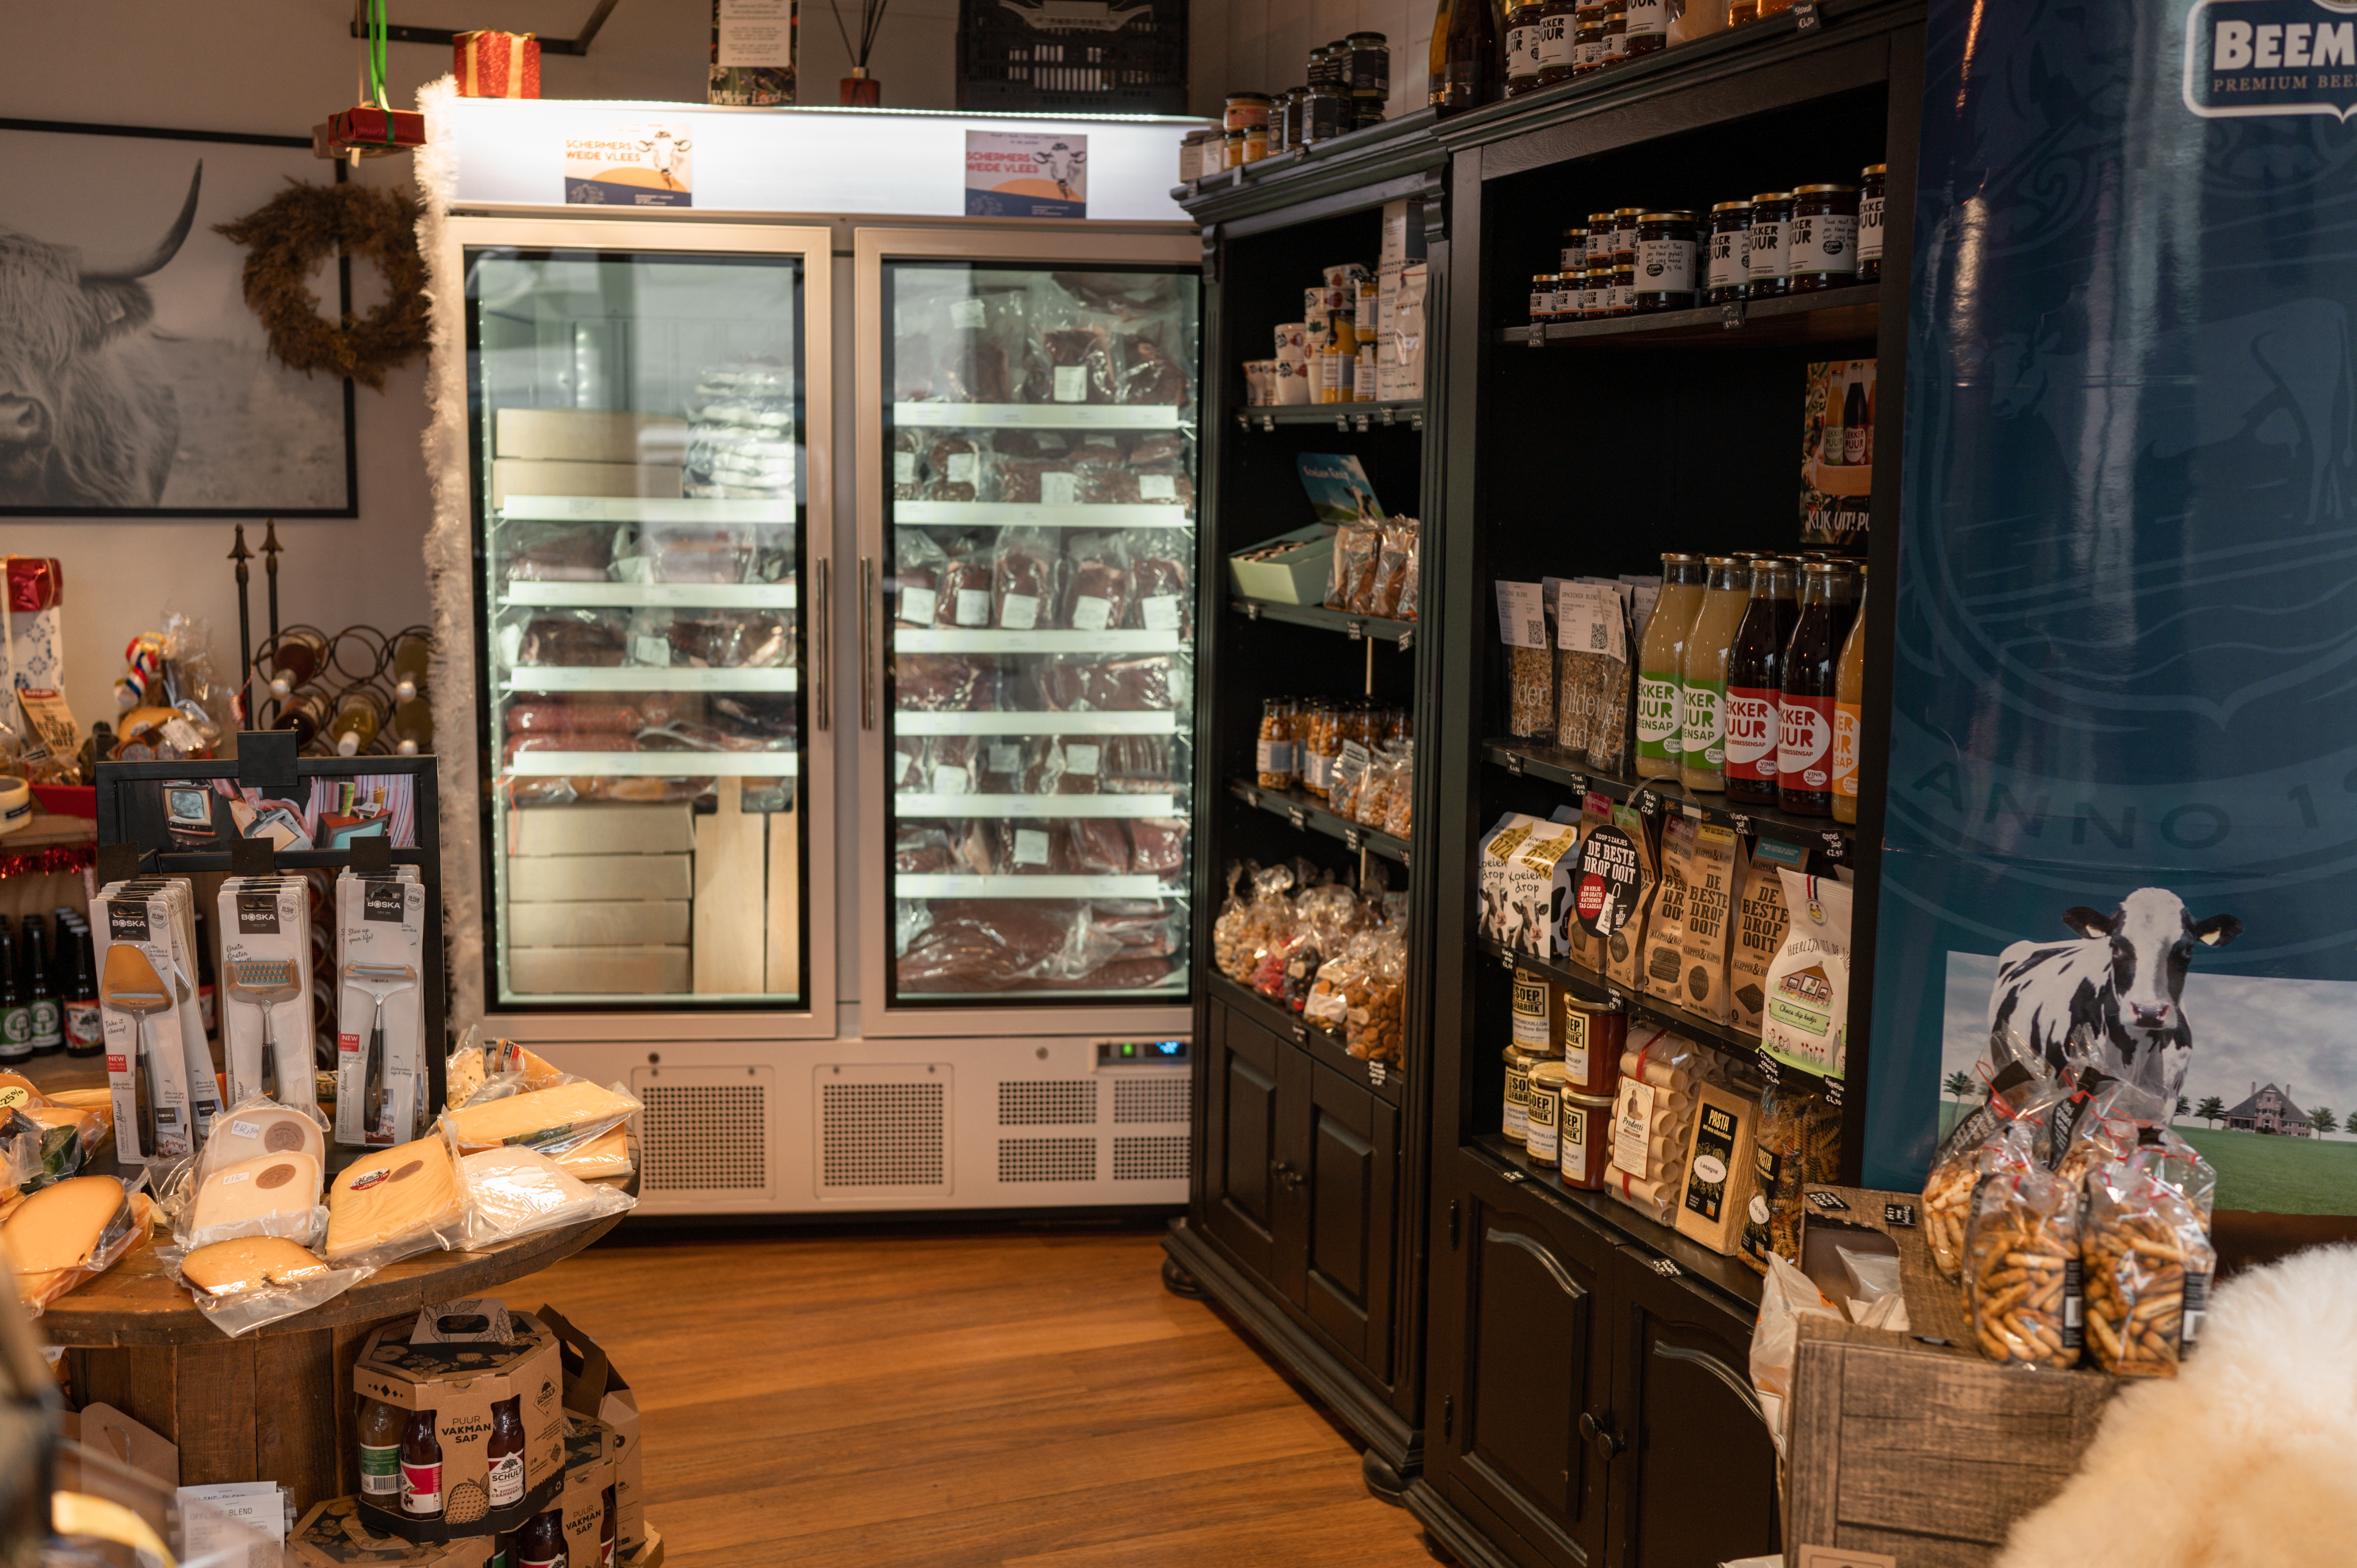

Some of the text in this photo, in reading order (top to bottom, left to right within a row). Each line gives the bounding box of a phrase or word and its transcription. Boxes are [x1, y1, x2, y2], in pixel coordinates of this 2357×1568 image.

[2214, 76, 2308, 92] PREMIUM
[712, 90, 781, 104] Wilder Land
[565, 140, 632, 150] SCHERMERS
[565, 151, 641, 162] WEIDE VLEES
[966, 151, 1031, 162] SCHERMERS
[966, 162, 1039, 173] WEIDE VLEES
[1845, 430, 1864, 439] LEKKER
[1845, 439, 1864, 449] PUUR
[1808, 510, 1856, 531] KIJK UIT!
[1506, 752, 1516, 763] Thee
[1643, 790, 1656, 802] Peren
[1912, 760, 2230, 850] ANNO
[1730, 812, 1748, 821] Vlierbes
[1596, 832, 1608, 841] KOOP
[1611, 836, 1628, 846] ZAKJES
[1587, 839, 1636, 867] DE BESTE
[1695, 848, 1718, 861] KLEPPER &
[1583, 855, 1636, 885] DROP OOIT
[1753, 860, 1778, 874] KLEPPER &
[1482, 869, 1504, 885] drop
[1705, 873, 1721, 891] DE
[1515, 881, 1539, 898] drop
[1757, 886, 1779, 904] DE
[1688, 885, 1728, 909] BESTE
[367, 900, 401, 909] BOSKA
[1742, 899, 1789, 924] BESTE
[1689, 901, 1724, 923] DROP
[112, 919, 146, 927] BOSKA
[1690, 917, 1720, 938] OOIT
[1742, 915, 1783, 938] DROP
[362, 933, 373, 943] life!
[1650, 930, 1668, 943] KLEPPER
[1743, 931, 1777, 954] OOIT
[226, 943, 244, 953] Grate
[1683, 945, 1721, 964] KLEPPER & KLEPPER
[1788, 938, 1820, 957] HEERLIJK
[1832, 943, 1839, 956] DE
[227, 951, 248, 961] Grater
[1733, 961, 1760, 976] KLEPPER &
[1689, 977, 1709, 989] KLEPPER
[1608, 987, 1621, 998] Klepper
[1515, 1001, 1540, 1013] FABRIEK
[1612, 997, 1621, 1007] drop
[1794, 1011, 1804, 1020] chip
[108, 1025, 126, 1035] cheesy!
[1760, 1051, 1777, 1068] Choco
[1758, 1064, 1768, 1074] mix
[1760, 1060, 1778, 1077] cookie
[0, 1089, 24, 1106] -25%
[1830, 1089, 1841, 1098] mix
[1622, 1116, 1644, 1131] Prodotti
[1708, 1109, 1730, 1132] PASTA
[234, 1122, 258, 1135] €12,50
[1757, 1148, 1773, 1172] PASTA
[1700, 1161, 1719, 1175] Lasagne
[537, 1389, 556, 1406] SCHULP
[452, 1416, 481, 1425] PUUR
[442, 1423, 491, 1436] VAKMAN
[455, 1434, 478, 1443] SAP
[492, 1467, 523, 1481] SCHULP
[190, 1507, 253, 1520] OFFLINE BLEND
[573, 1504, 594, 1519] PUUR
[565, 1509, 601, 1531] VAKMAN
[576, 1523, 593, 1535] SAP
